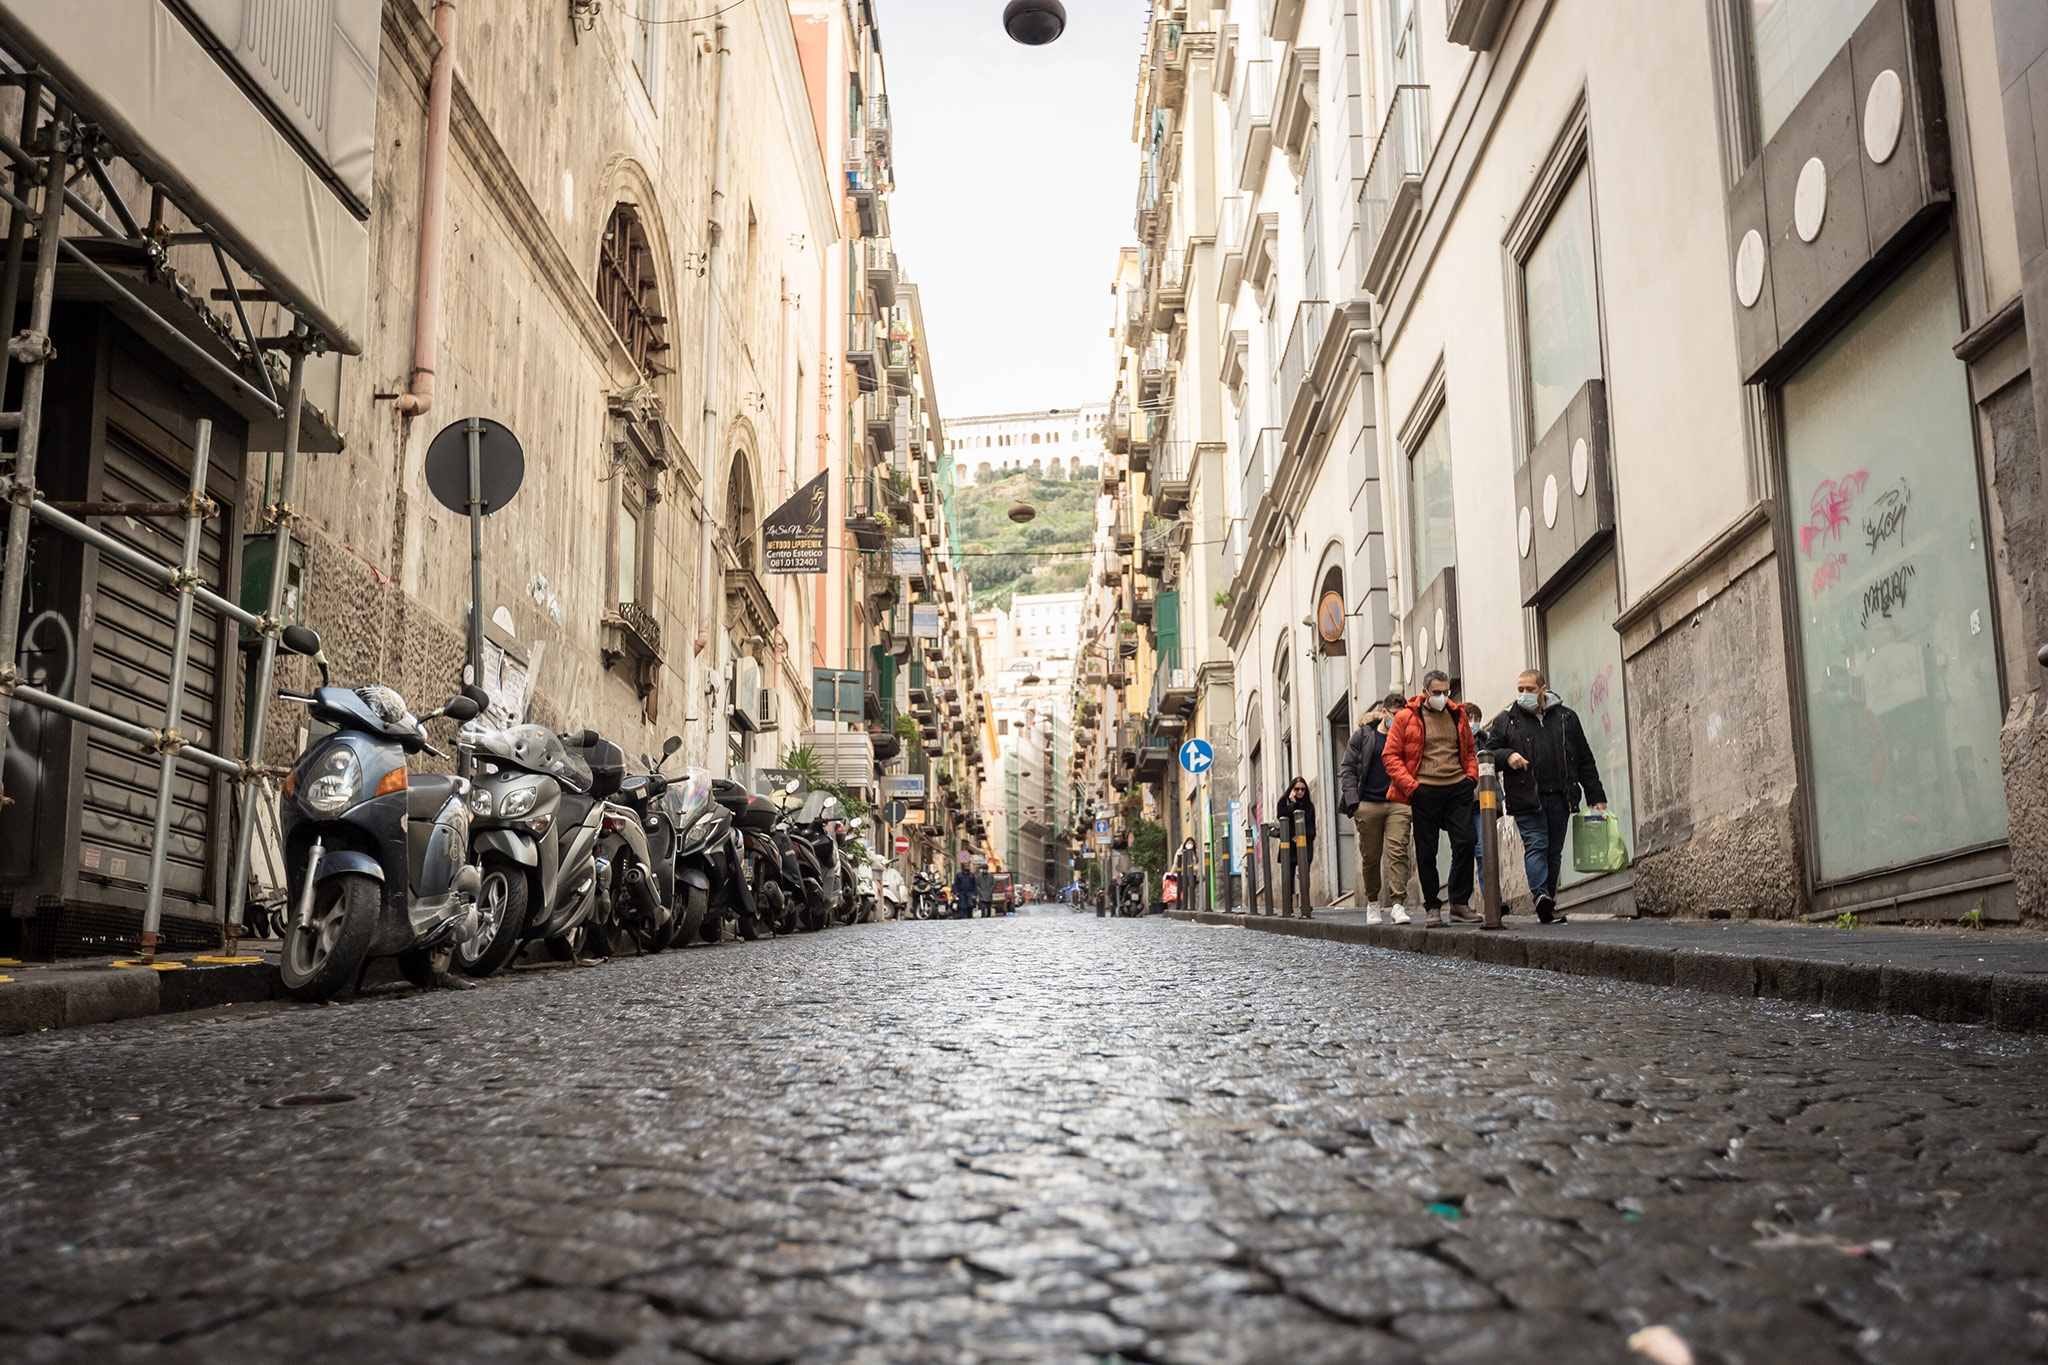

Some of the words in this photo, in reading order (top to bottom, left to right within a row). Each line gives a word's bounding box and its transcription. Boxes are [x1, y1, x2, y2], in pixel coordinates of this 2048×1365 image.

[766, 540, 791, 549] METODO
[766, 550, 792, 558] Centro
[792, 549, 823, 558] Estetico
[770, 558, 818, 567] 081.0132401
